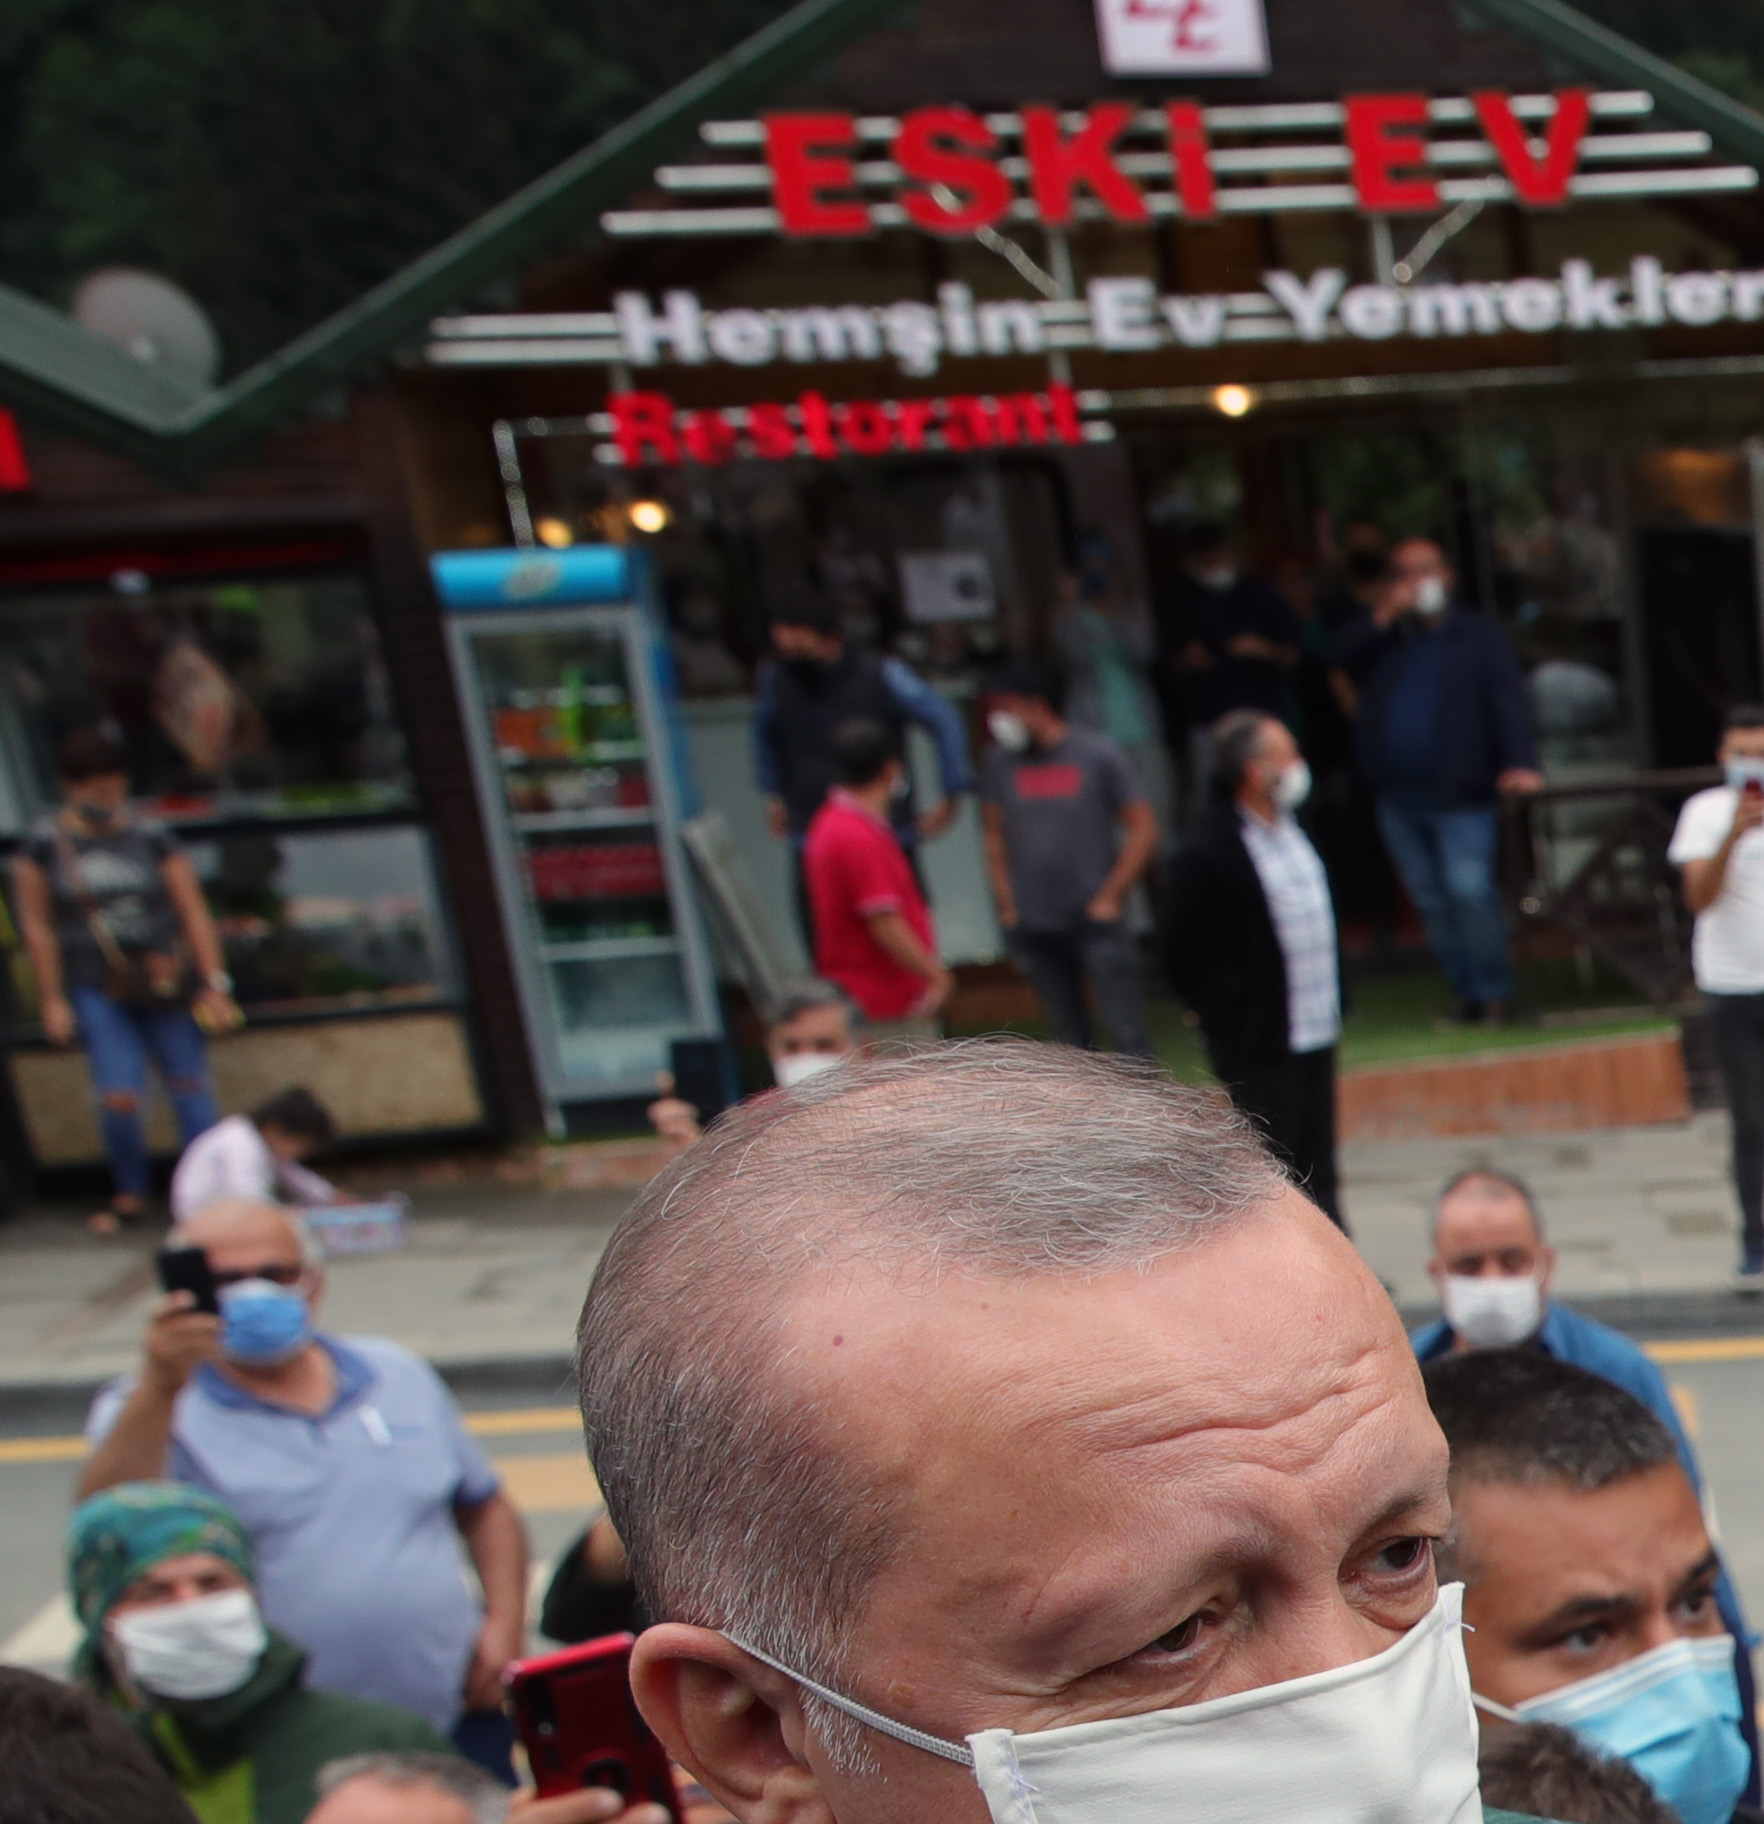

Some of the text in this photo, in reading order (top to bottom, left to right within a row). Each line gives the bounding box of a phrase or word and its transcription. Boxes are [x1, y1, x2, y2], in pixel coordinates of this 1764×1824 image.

[1342, 88, 1592, 212] EV
[612, 284, 1044, 376] Hemşin
[1087, 276, 1228, 350] Ev
